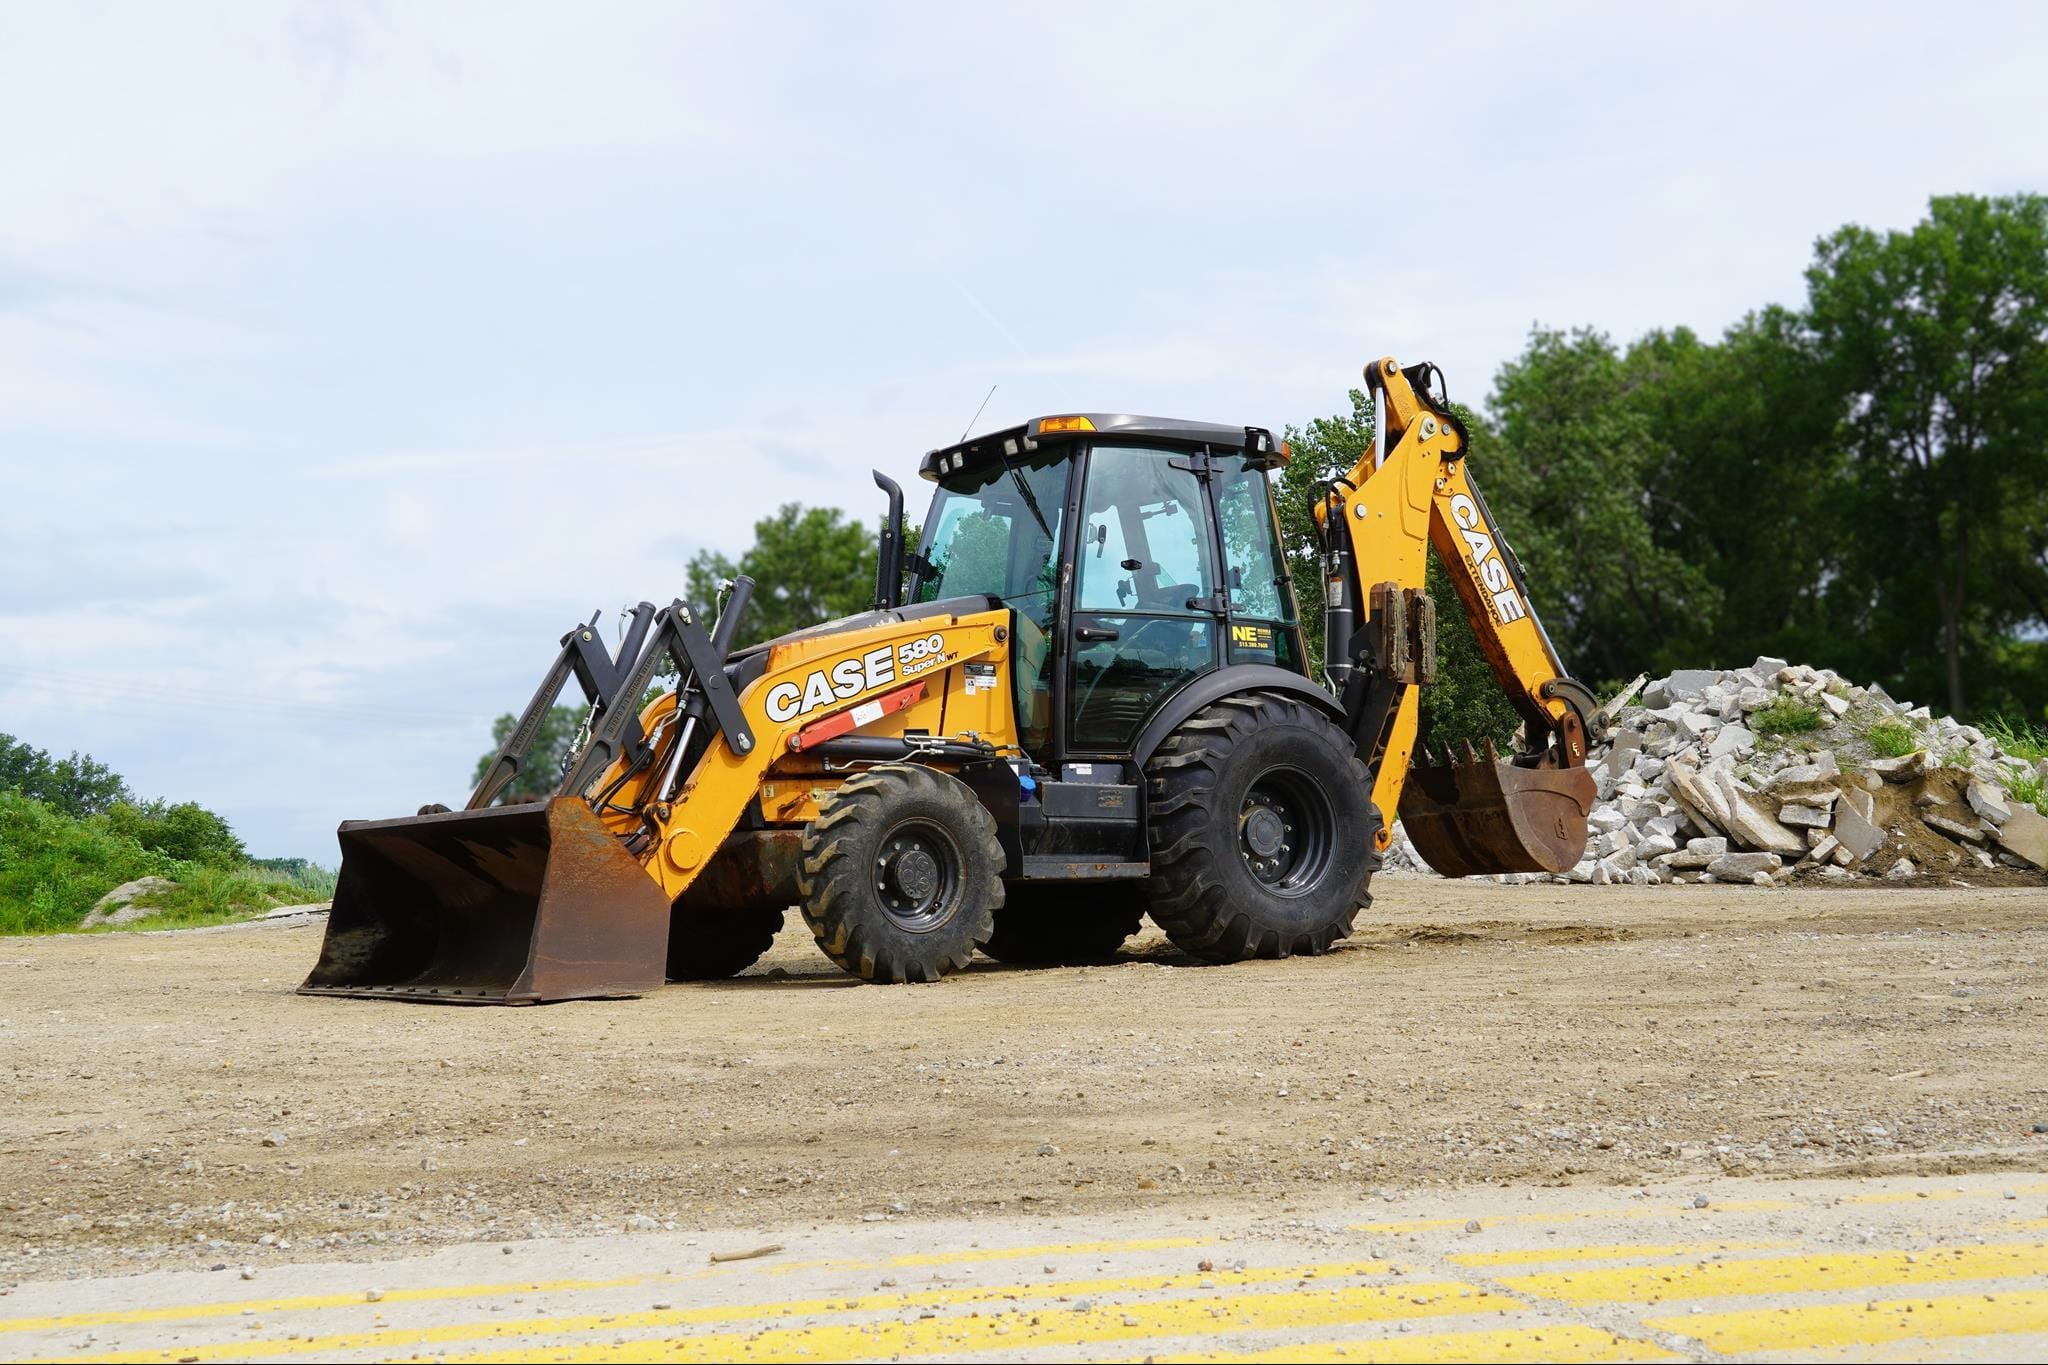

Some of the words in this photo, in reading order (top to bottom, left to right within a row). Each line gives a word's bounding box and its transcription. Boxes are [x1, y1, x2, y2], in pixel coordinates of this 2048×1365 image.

[1450, 493, 1526, 624] CASE
[1464, 554, 1503, 628] EXTENDAHOE
[898, 633, 944, 664] 580
[1232, 626, 1257, 641] NE
[766, 645, 895, 722] CASE
[902, 658, 934, 675] Super
[946, 651, 958, 661] WT
